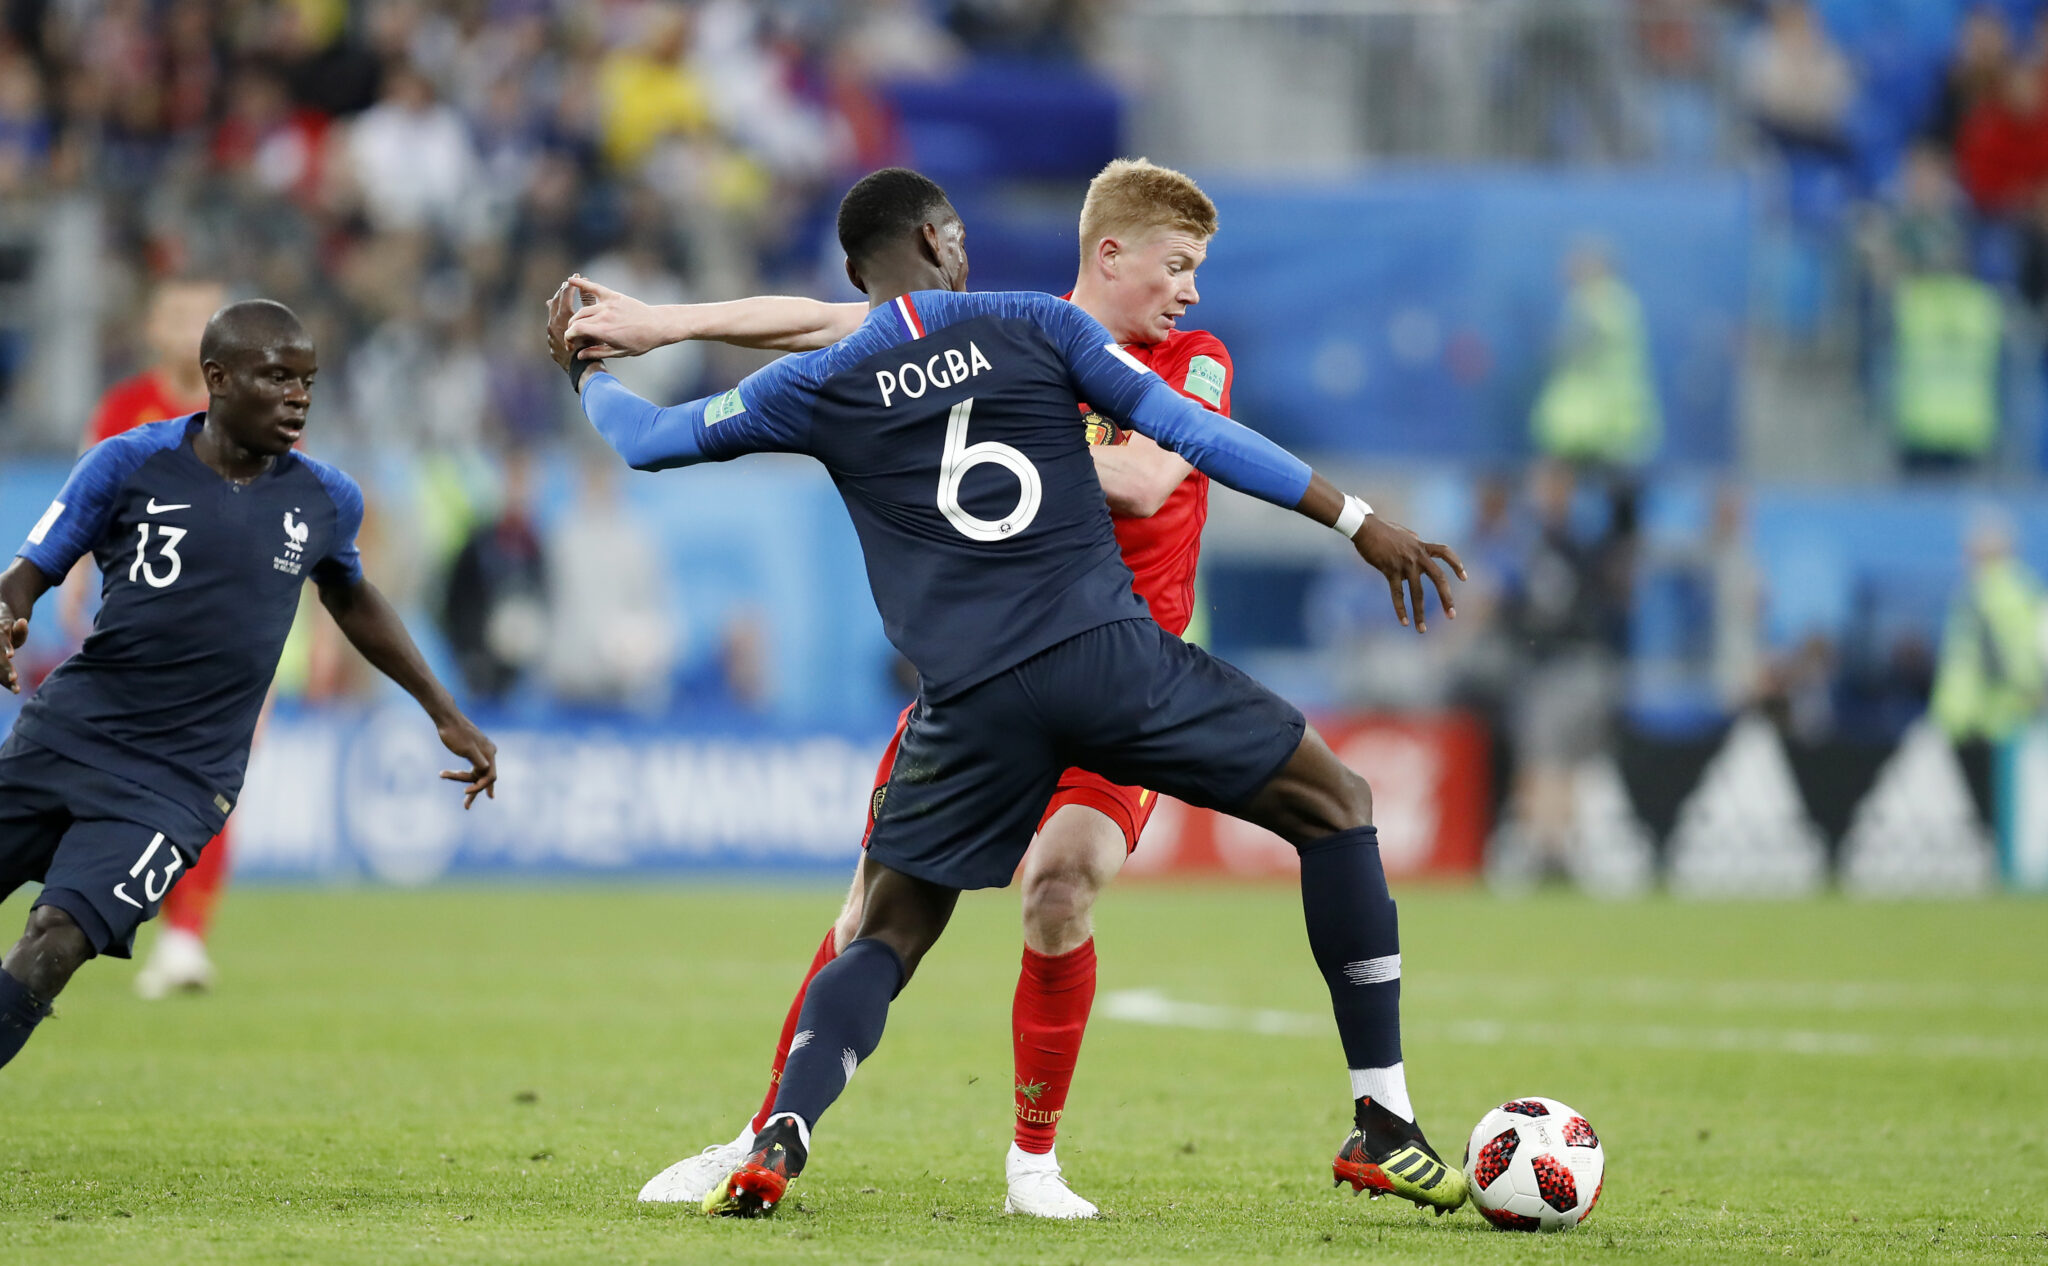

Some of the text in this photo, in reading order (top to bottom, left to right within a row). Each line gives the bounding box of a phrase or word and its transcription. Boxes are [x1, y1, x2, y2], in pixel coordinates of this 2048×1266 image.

[876, 340, 993, 407] POGBA
[936, 396, 1042, 542] 6
[128, 522, 188, 588] 13
[128, 831, 183, 902] 13
